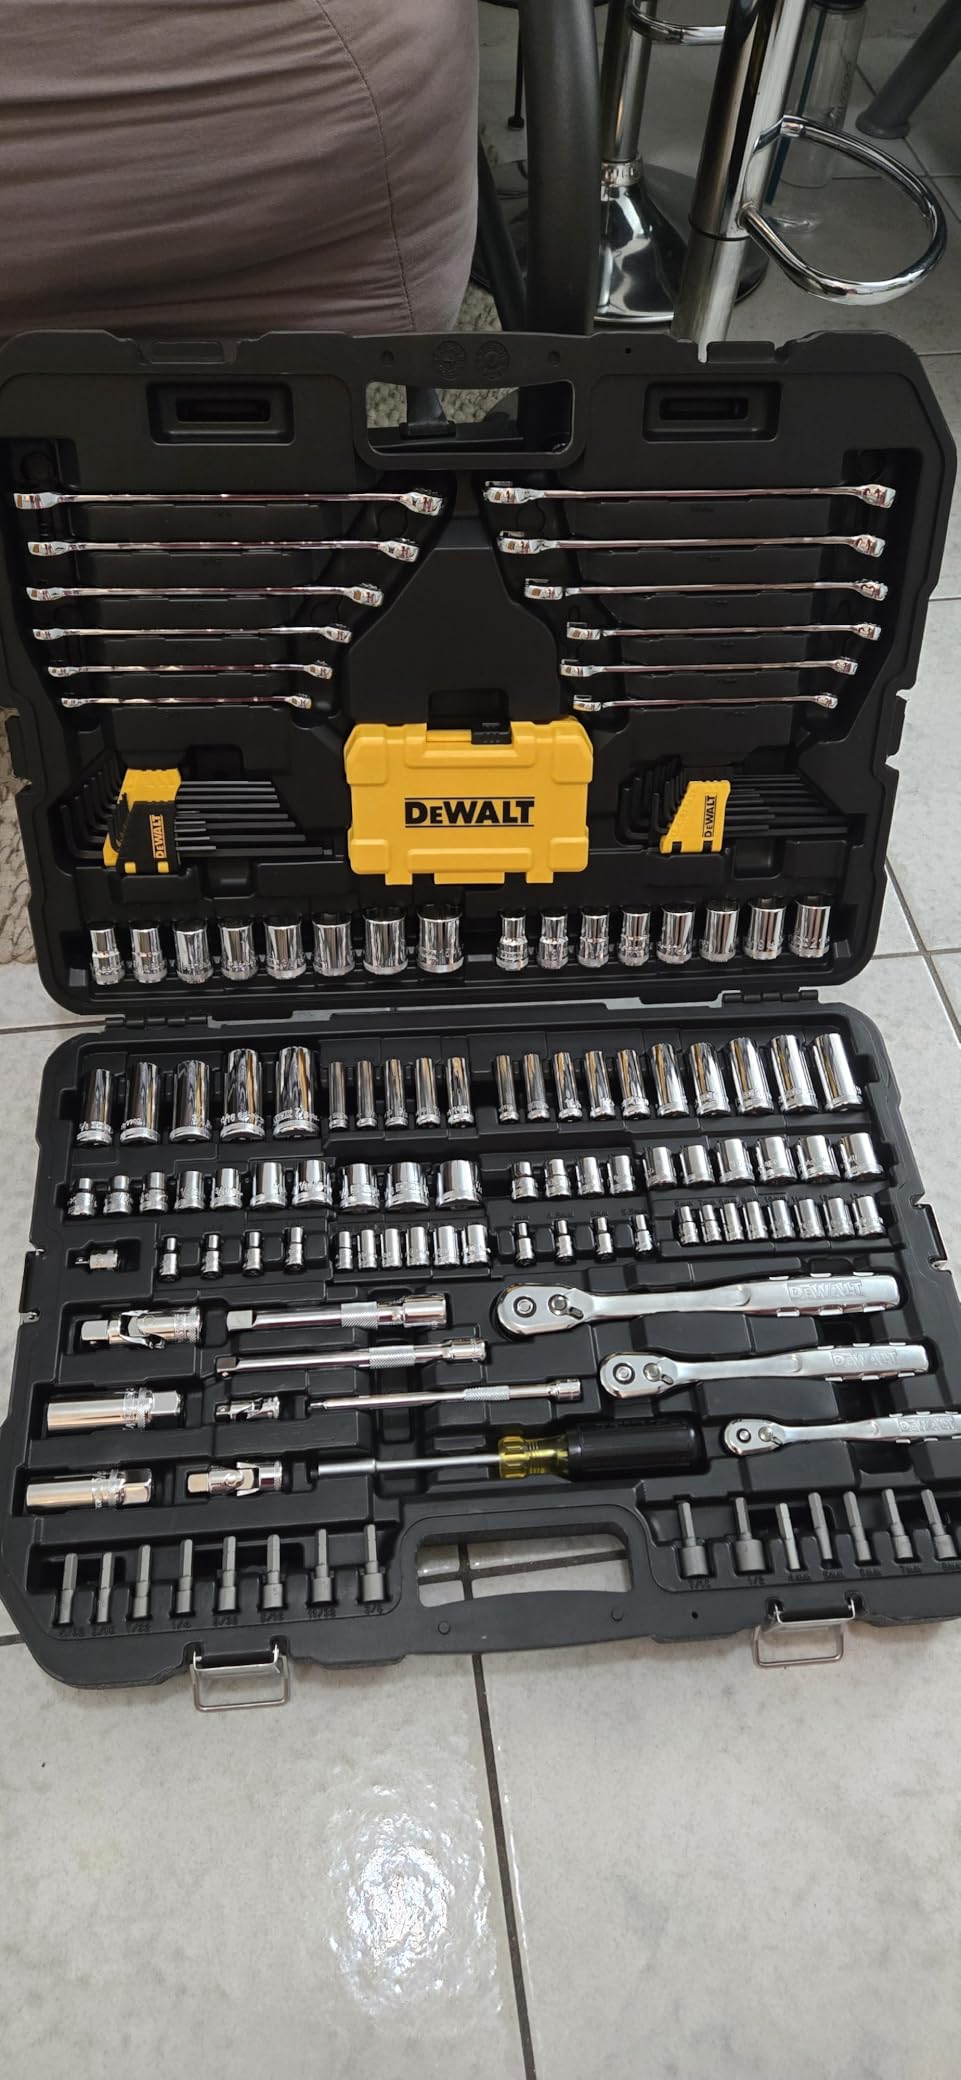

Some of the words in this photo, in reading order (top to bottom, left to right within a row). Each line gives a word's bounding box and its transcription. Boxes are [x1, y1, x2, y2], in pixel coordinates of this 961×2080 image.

[404, 800, 535, 825] DEWALT
[704, 795, 715, 838] DEWALT
[151, 815, 166, 859] DEWALT
[788, 1281, 864, 1299] DEWALT
